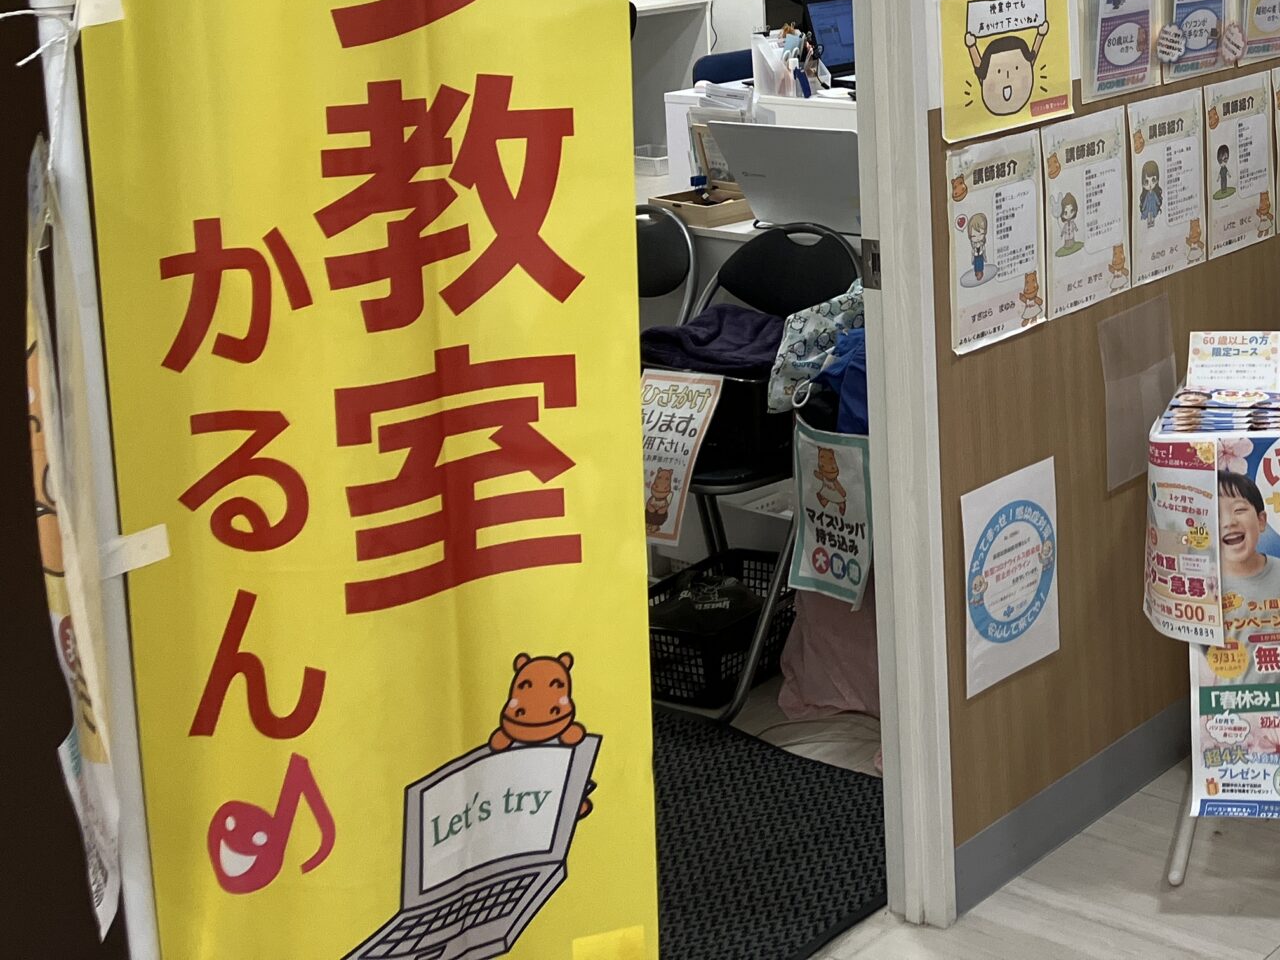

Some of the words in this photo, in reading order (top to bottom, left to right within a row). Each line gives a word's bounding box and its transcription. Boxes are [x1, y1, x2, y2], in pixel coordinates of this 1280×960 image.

[989, 0, 1026, 15] 授業中でも
[1107, 33, 1135, 49] 80歳以上
[1222, 95, 1254, 117] 講師紹介
[1148, 117, 1184, 140] 講師紹介
[1065, 138, 1106, 164] 講師紹介
[972, 159, 1018, 186] 講師紹介
[1211, 347, 1258, 358] 限定コース
[643, 384, 712, 414] ひざかけ
[643, 436, 690, 457] 用下さい。
[159, 218, 326, 740] かるん
[805, 507, 866, 540] マイスリッパ
[815, 528, 859, 557] 持ち込み
[1174, 602, 1205, 622] 500
[1212, 652, 1236, 664] 3/31
[1217, 768, 1271, 780] プレゼント
[431, 794, 492, 848] Let's
[502, 784, 552, 817] try
